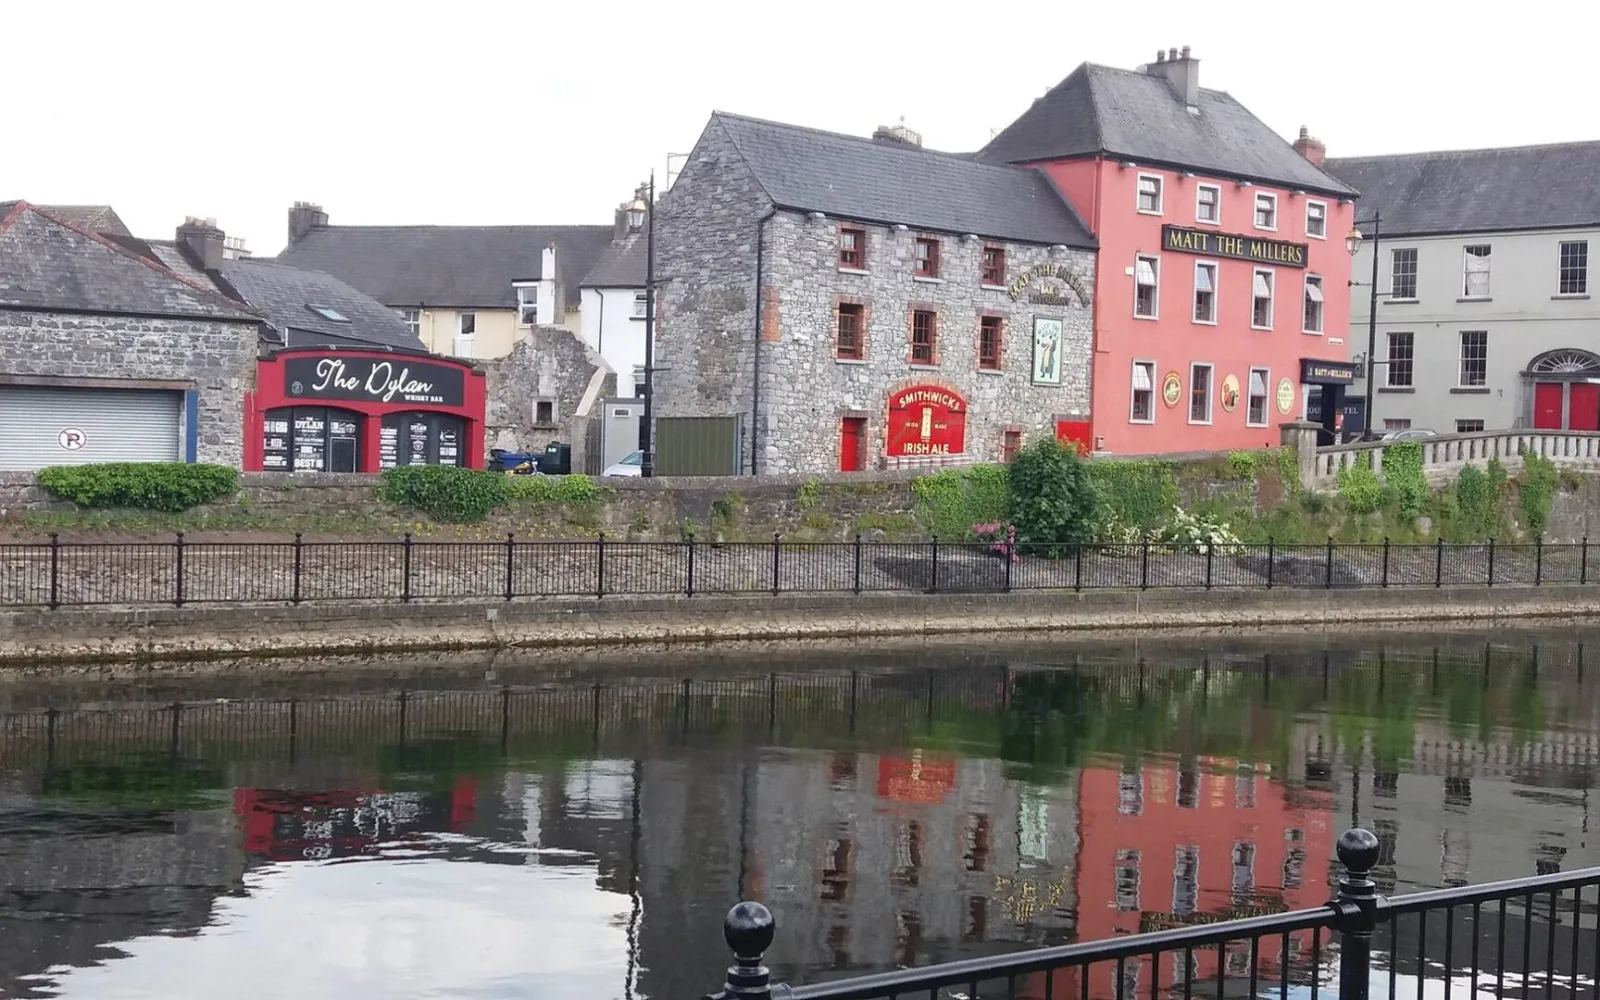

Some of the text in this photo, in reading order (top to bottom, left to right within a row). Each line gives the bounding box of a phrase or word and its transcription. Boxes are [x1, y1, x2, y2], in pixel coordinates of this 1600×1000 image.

[1170, 231, 1302, 263] MATT THE MILLERS
[1035, 264, 1055, 277] THE
[1039, 284, 1054, 295] BAR
[312, 358, 432, 402] The Dylan
[899, 390, 960, 410] SMITHWICKS
[294, 420, 324, 430] DYLAN
[904, 442, 949, 454] IRISH ALE
